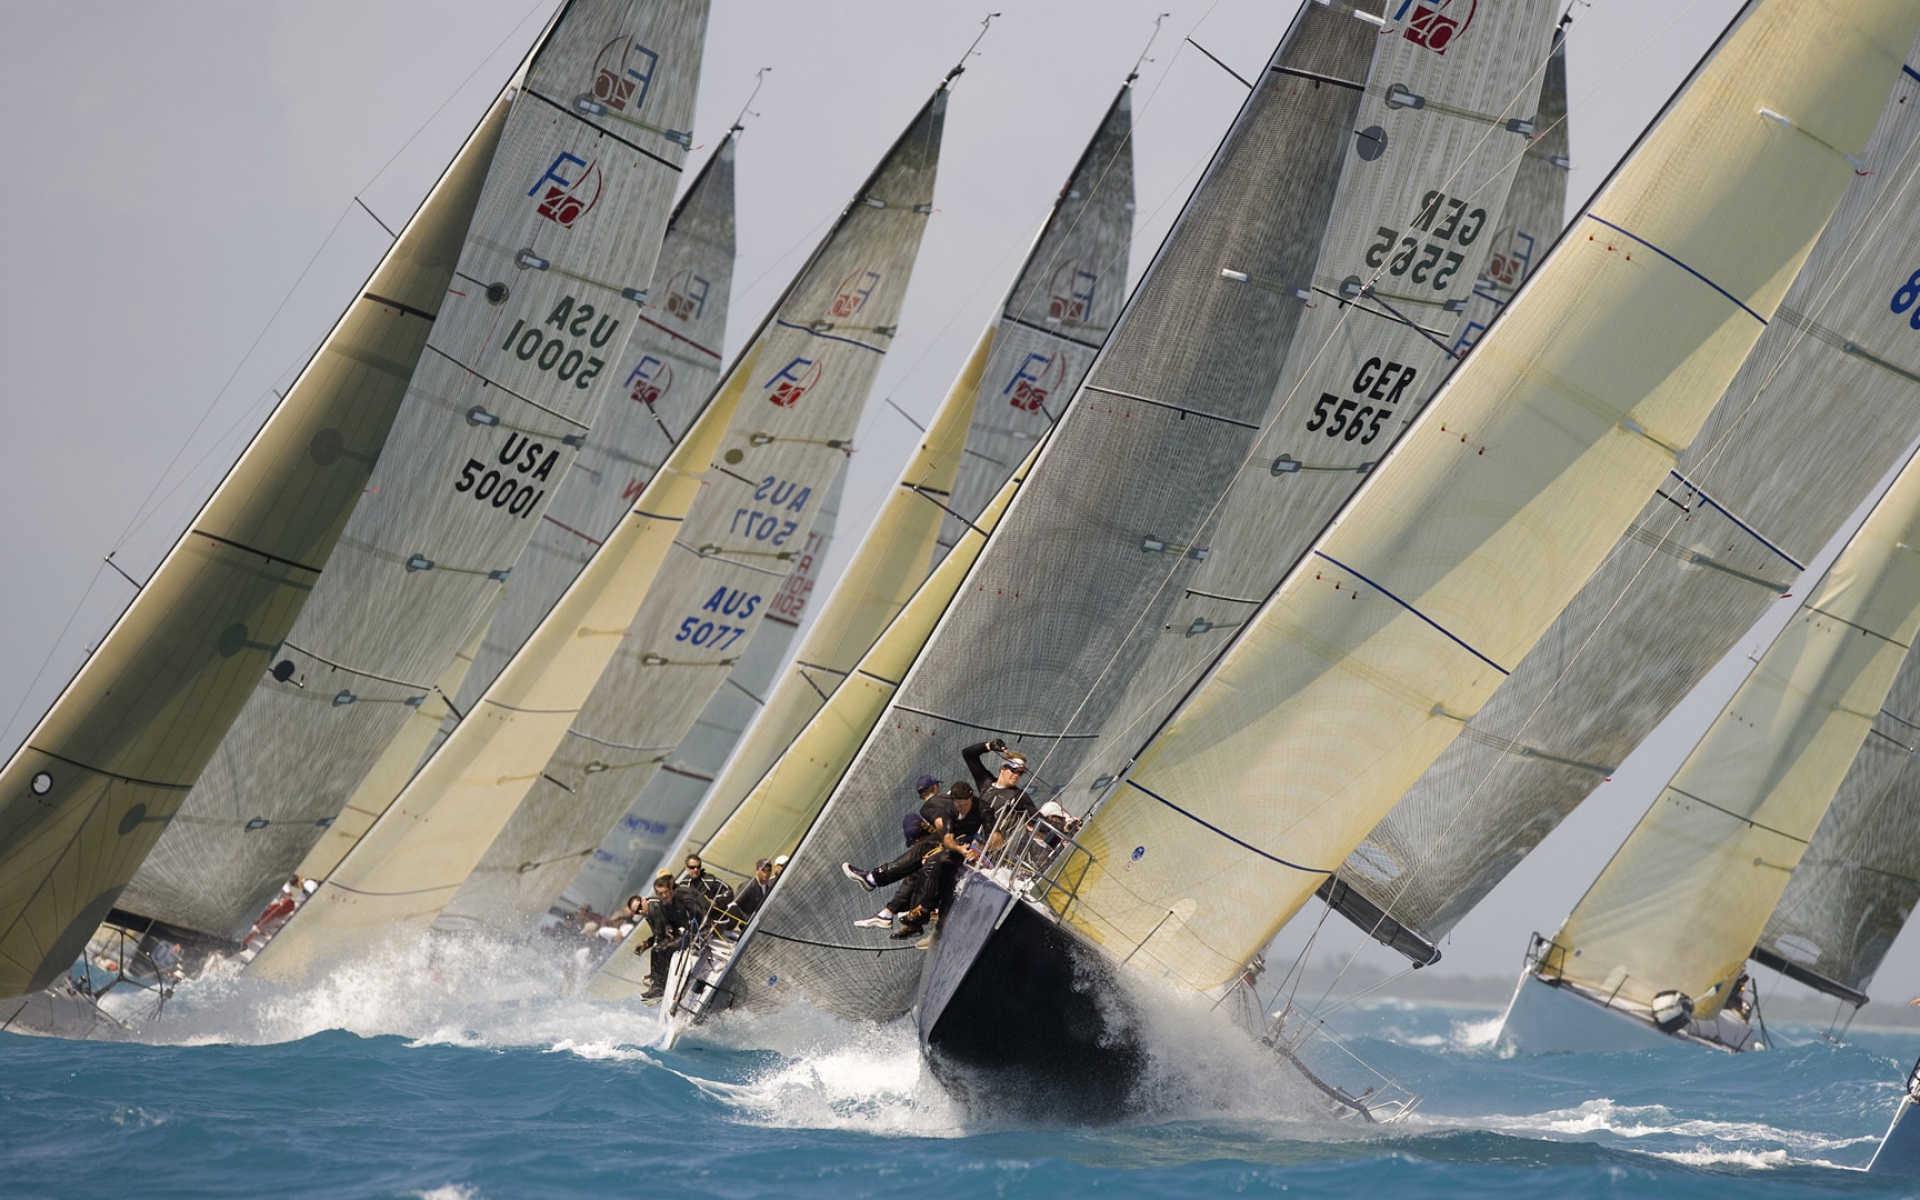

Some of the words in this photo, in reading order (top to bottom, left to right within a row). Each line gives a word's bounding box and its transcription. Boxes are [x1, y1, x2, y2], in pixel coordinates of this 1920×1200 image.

[1403, 5, 1458, 55] 40
[528, 151, 588, 197] F
[537, 186, 585, 229] 40
[623, 355, 661, 389] F
[764, 357, 813, 389] F
[1003, 352, 1050, 395] F
[1353, 357, 1418, 404] GER
[1306, 392, 1392, 445] 5565
[499, 432, 560, 482] USA
[455, 458, 544, 519] 50001
[702, 586, 761, 619] AUS
[675, 616, 746, 651] 5077
